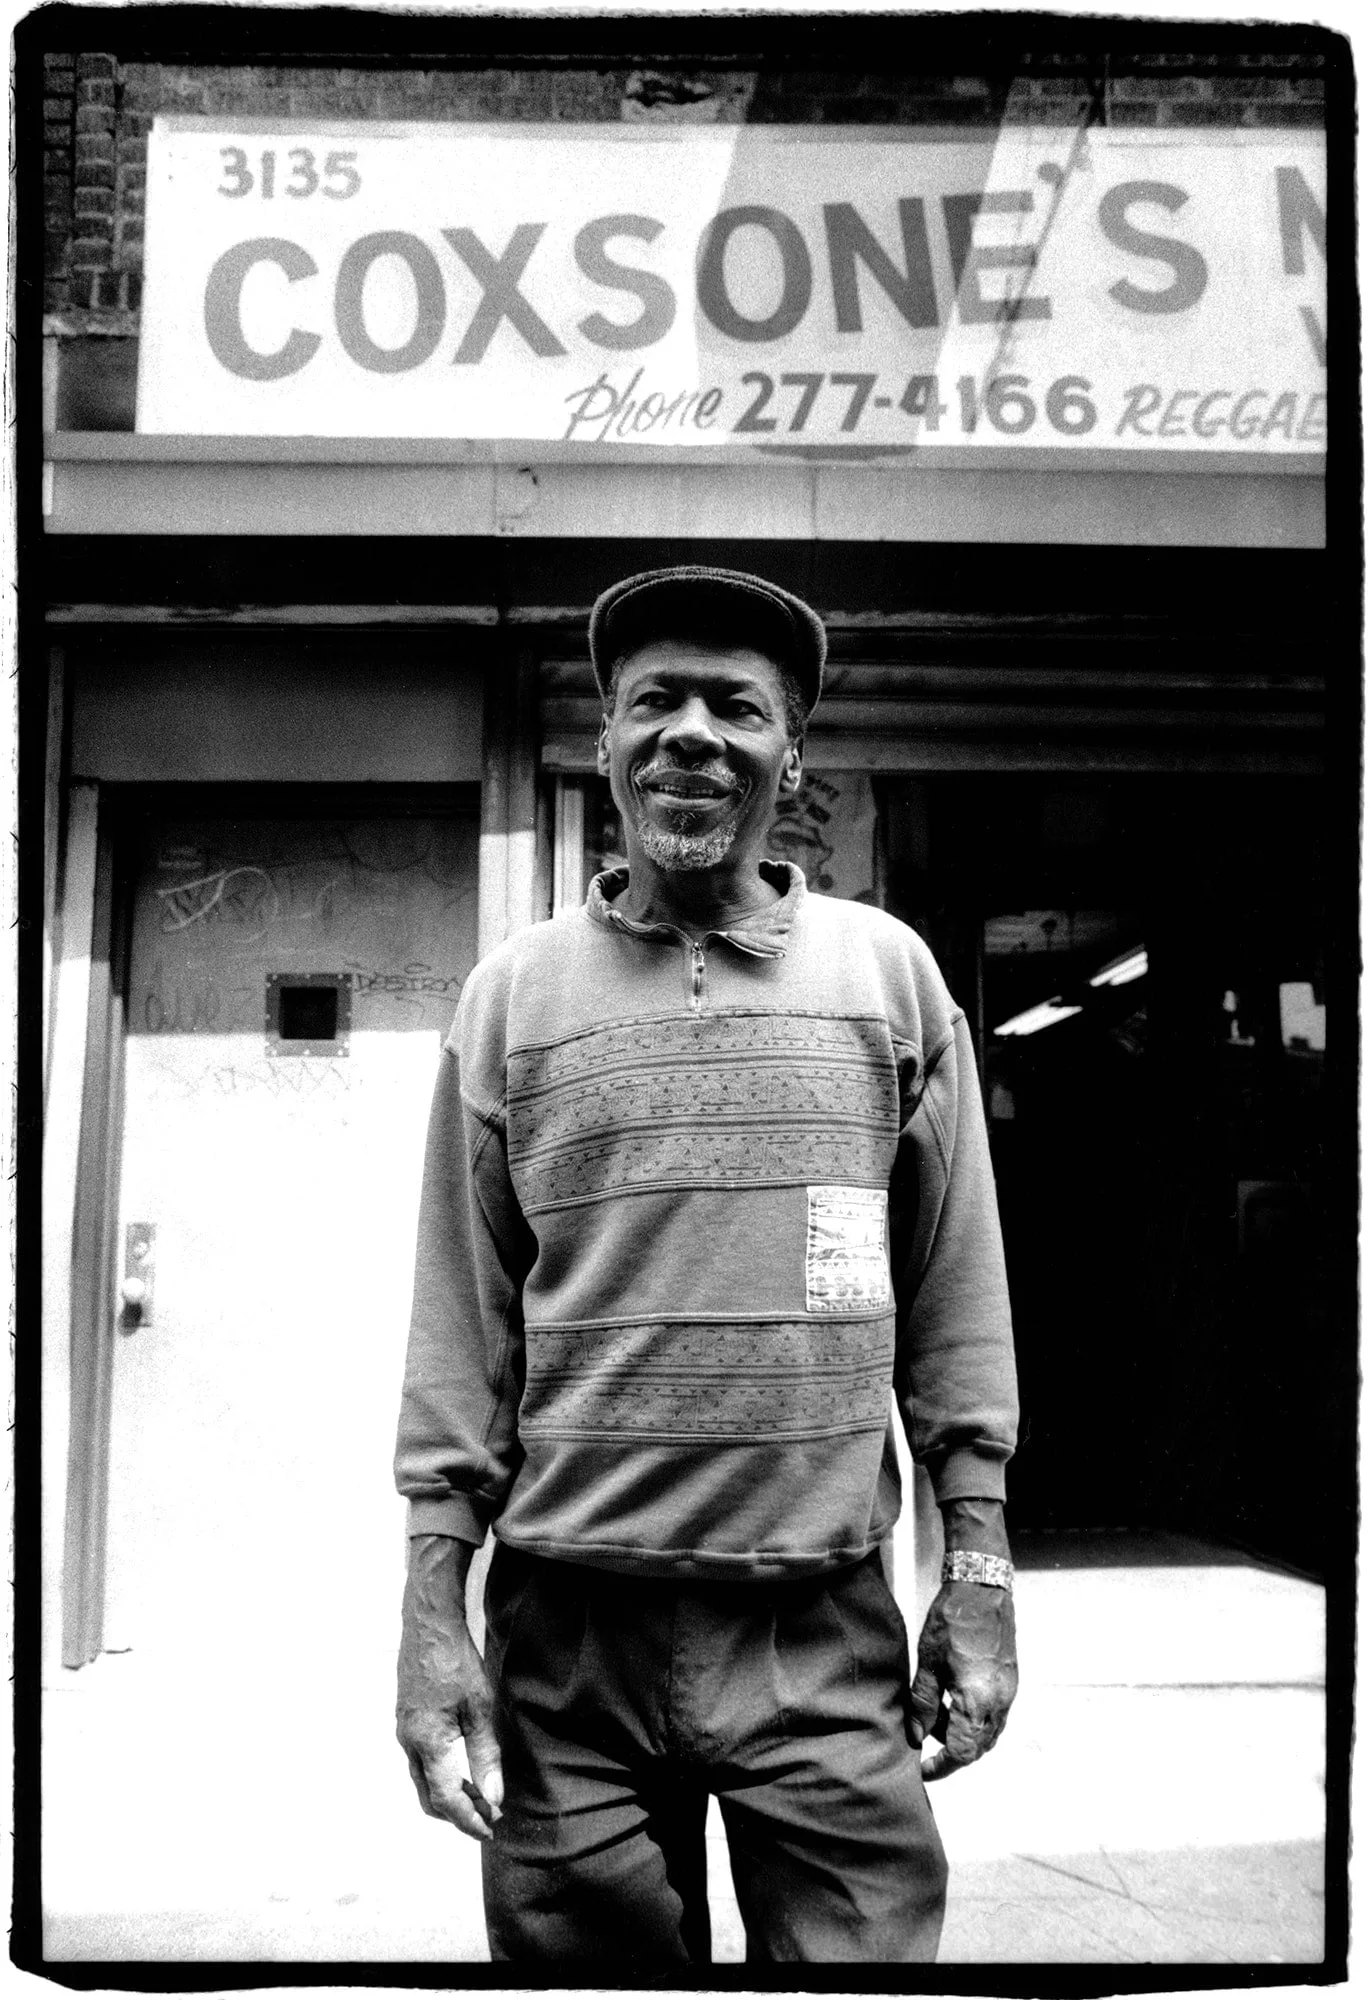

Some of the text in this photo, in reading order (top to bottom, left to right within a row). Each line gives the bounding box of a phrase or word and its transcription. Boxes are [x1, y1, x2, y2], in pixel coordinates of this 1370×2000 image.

[217, 145, 362, 200] 3135
[203, 161, 1209, 382] COXSONE'S
[563, 366, 1327, 442] Phone 277-4166 REGGAE
